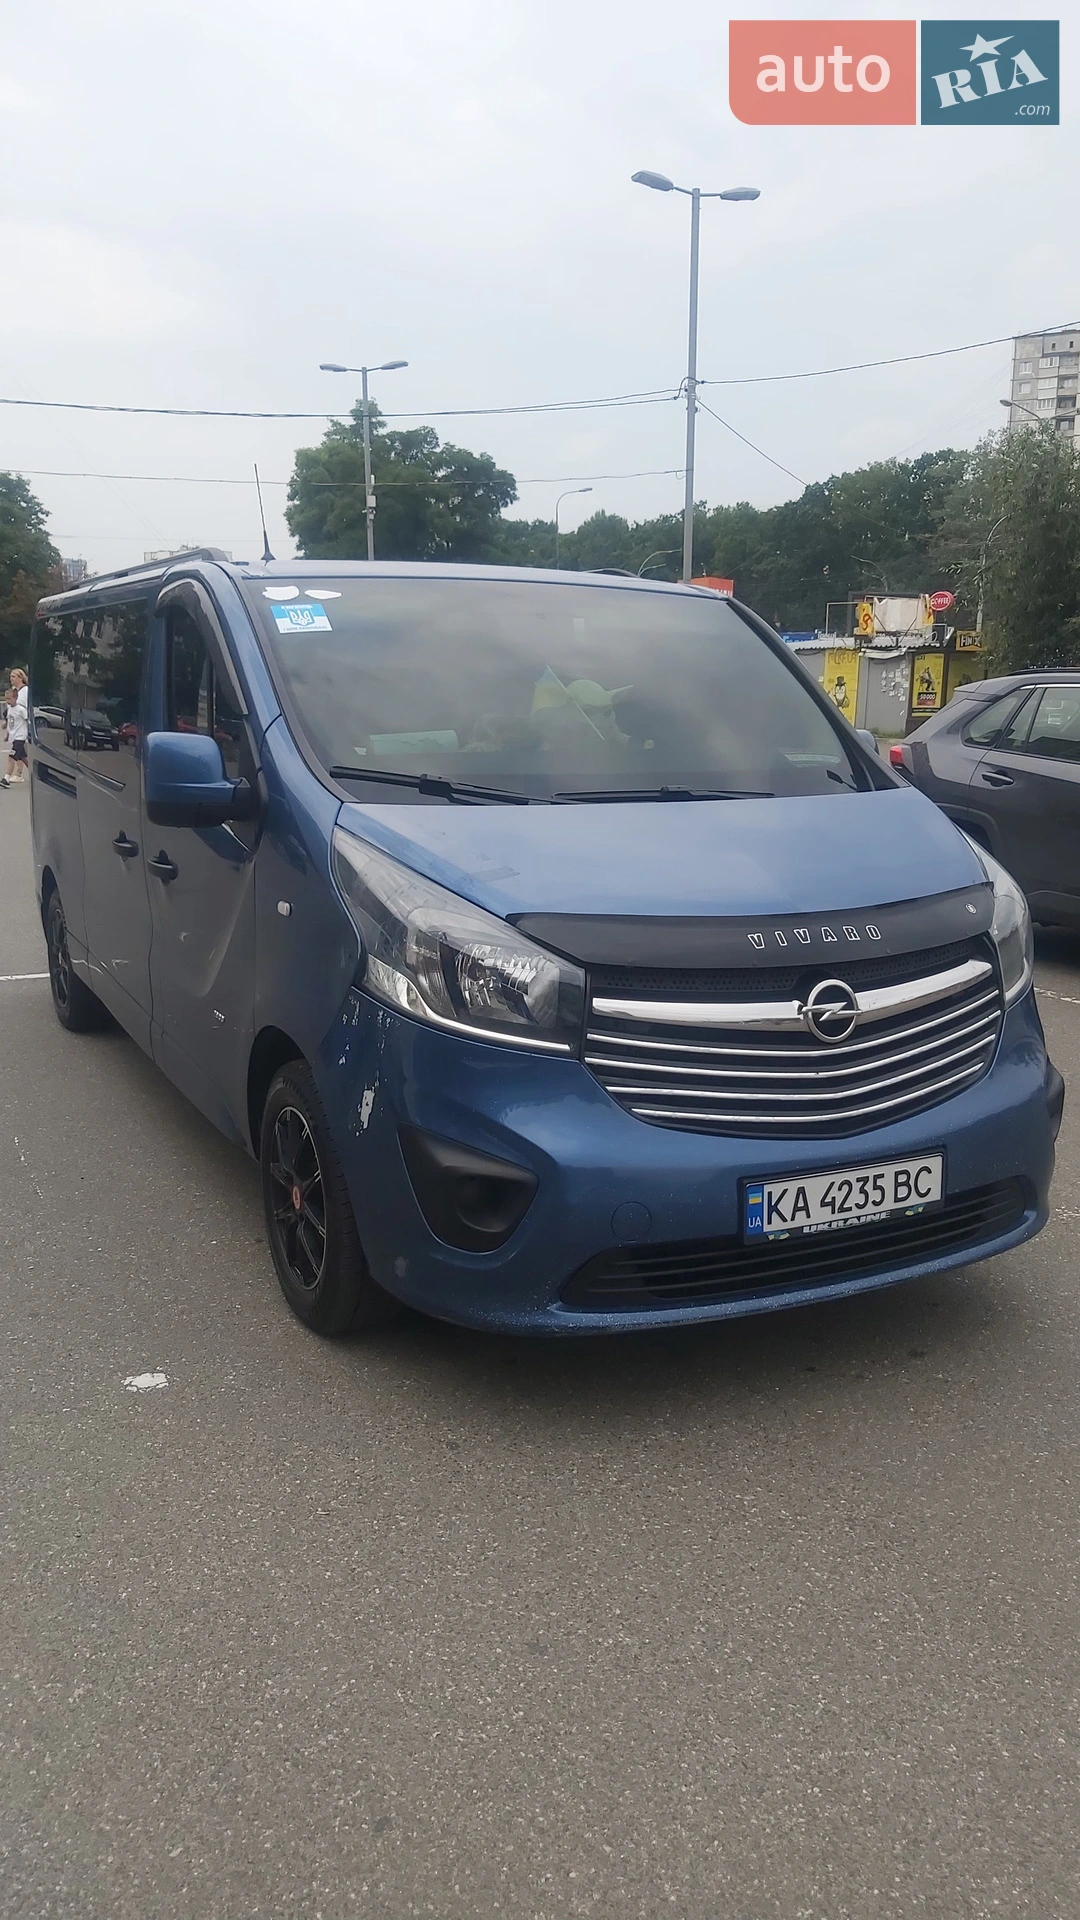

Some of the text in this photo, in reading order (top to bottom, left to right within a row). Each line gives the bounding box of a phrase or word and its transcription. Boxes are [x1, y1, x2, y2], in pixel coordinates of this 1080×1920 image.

[931, 597, 949, 605] COFFEE
[747, 925, 882, 949] VIVARO
[767, 1166, 933, 1225] KA 4235 BC
[748, 1217, 762, 1228] UA
[802, 1211, 892, 1234] UKRAINE
